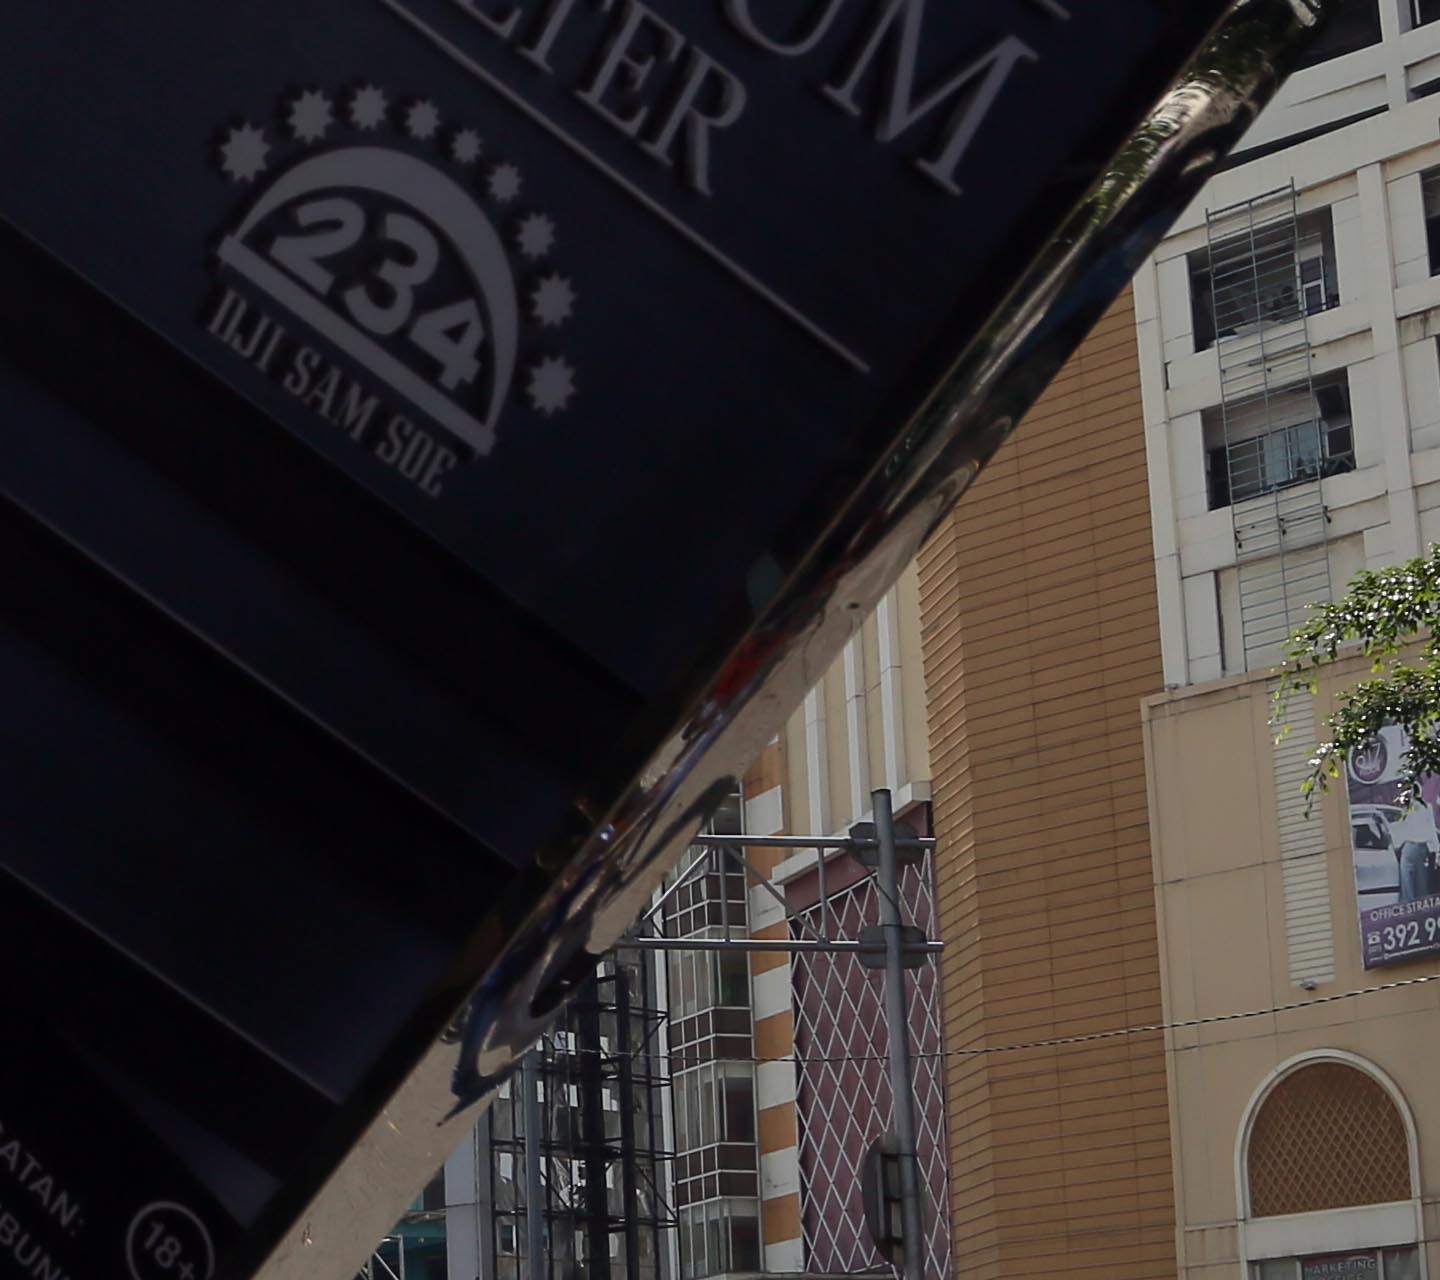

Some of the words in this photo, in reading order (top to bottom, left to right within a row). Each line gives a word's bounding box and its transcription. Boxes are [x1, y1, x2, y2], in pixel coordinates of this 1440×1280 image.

[268, 196, 486, 392] 234
[206, 287, 286, 373] DJI
[282, 346, 380, 443] SAM
[374, 413, 459, 500] SOE
[1370, 904, 1405, 922] OFFICE
[1383, 920, 1421, 951] 392
